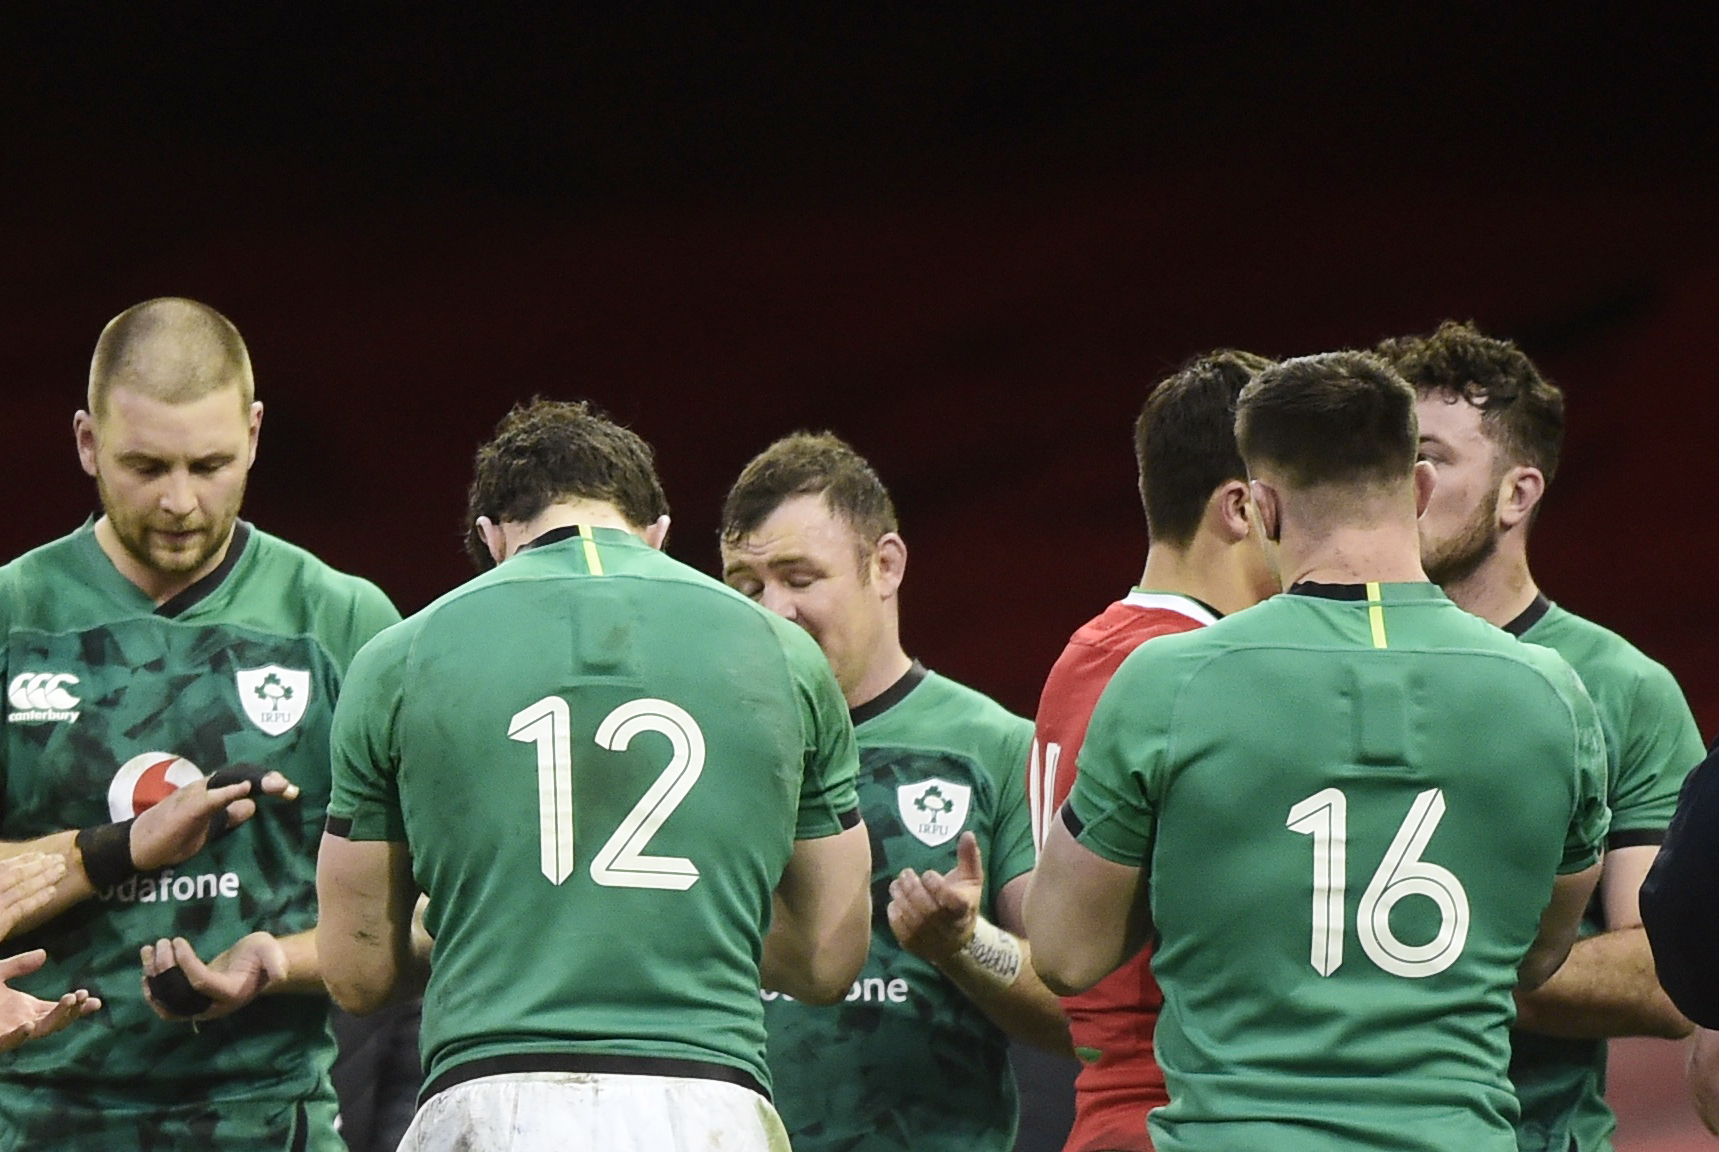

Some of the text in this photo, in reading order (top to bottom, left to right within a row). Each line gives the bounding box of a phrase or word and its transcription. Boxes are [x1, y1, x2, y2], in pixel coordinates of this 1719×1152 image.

[8, 709, 80, 724] canterbury
[261, 712, 291, 723] IRFU
[507, 695, 706, 891] 12
[918, 823, 949, 836] IRFU
[1285, 787, 1470, 978] 16
